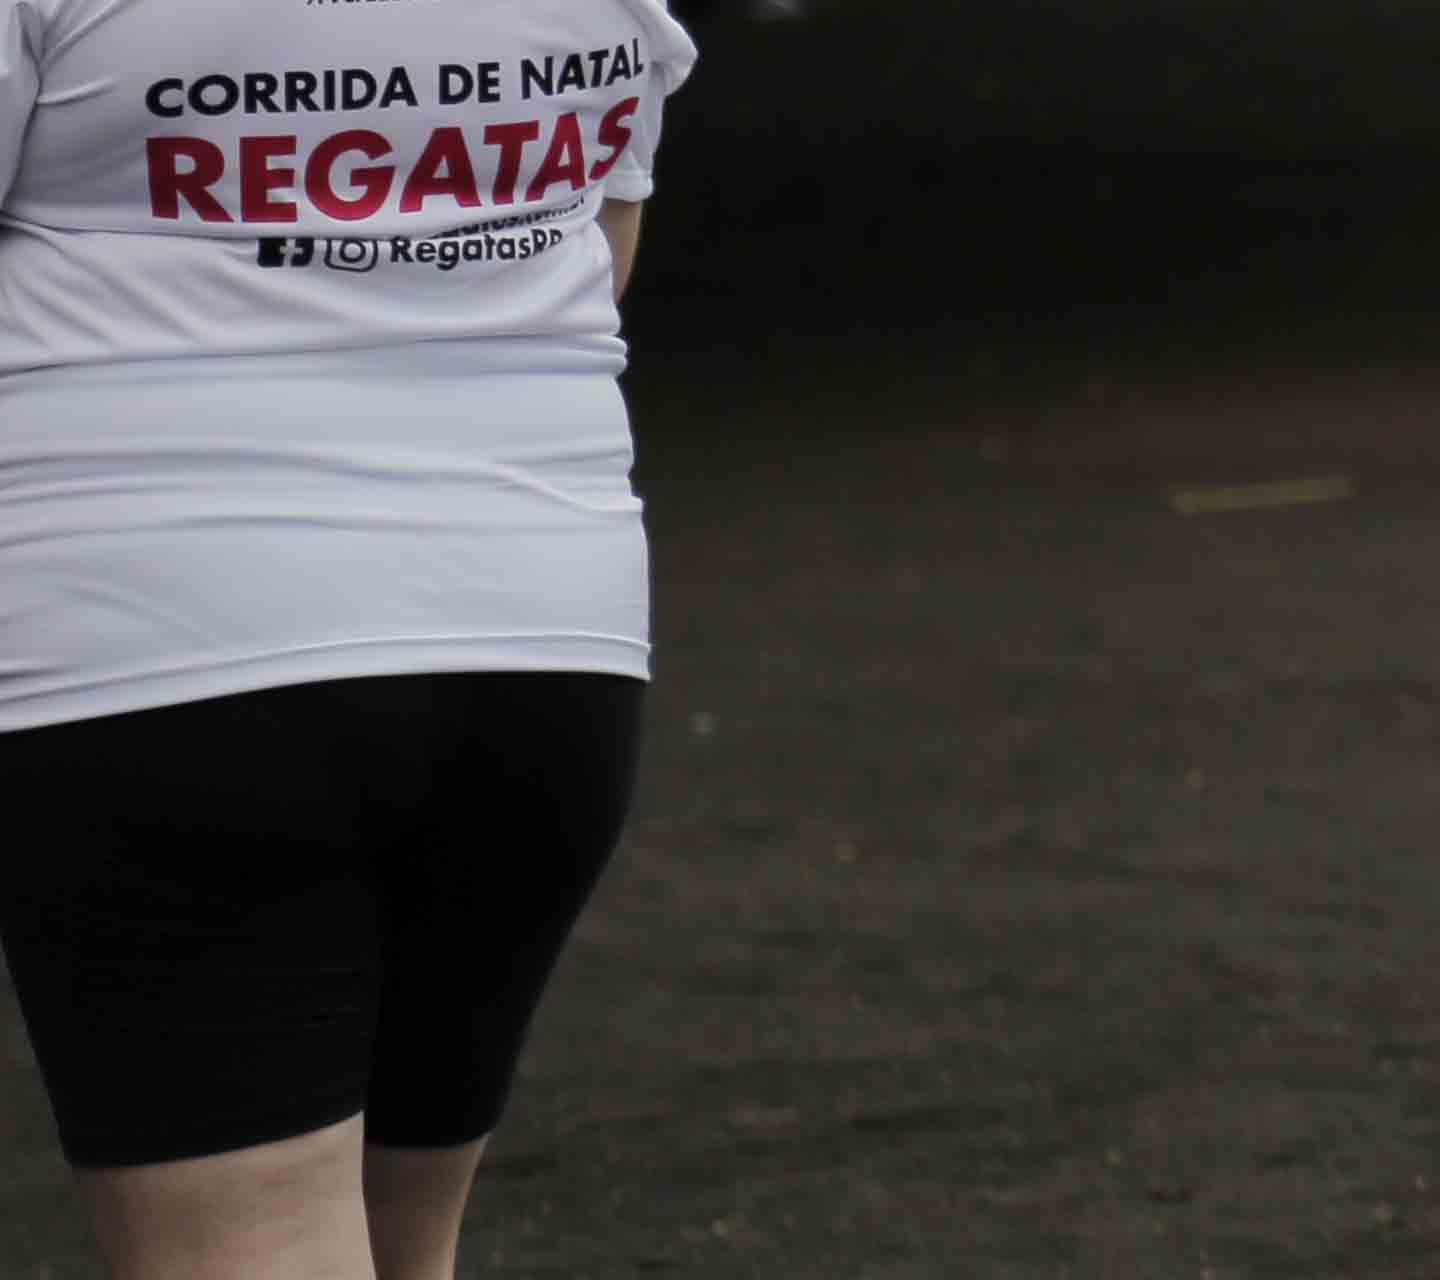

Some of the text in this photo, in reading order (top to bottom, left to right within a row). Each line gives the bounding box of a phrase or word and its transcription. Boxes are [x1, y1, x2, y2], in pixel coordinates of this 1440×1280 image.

[145, 38, 645, 118] CORRIDA DE NATAL
[145, 96, 640, 223] REGATAS
